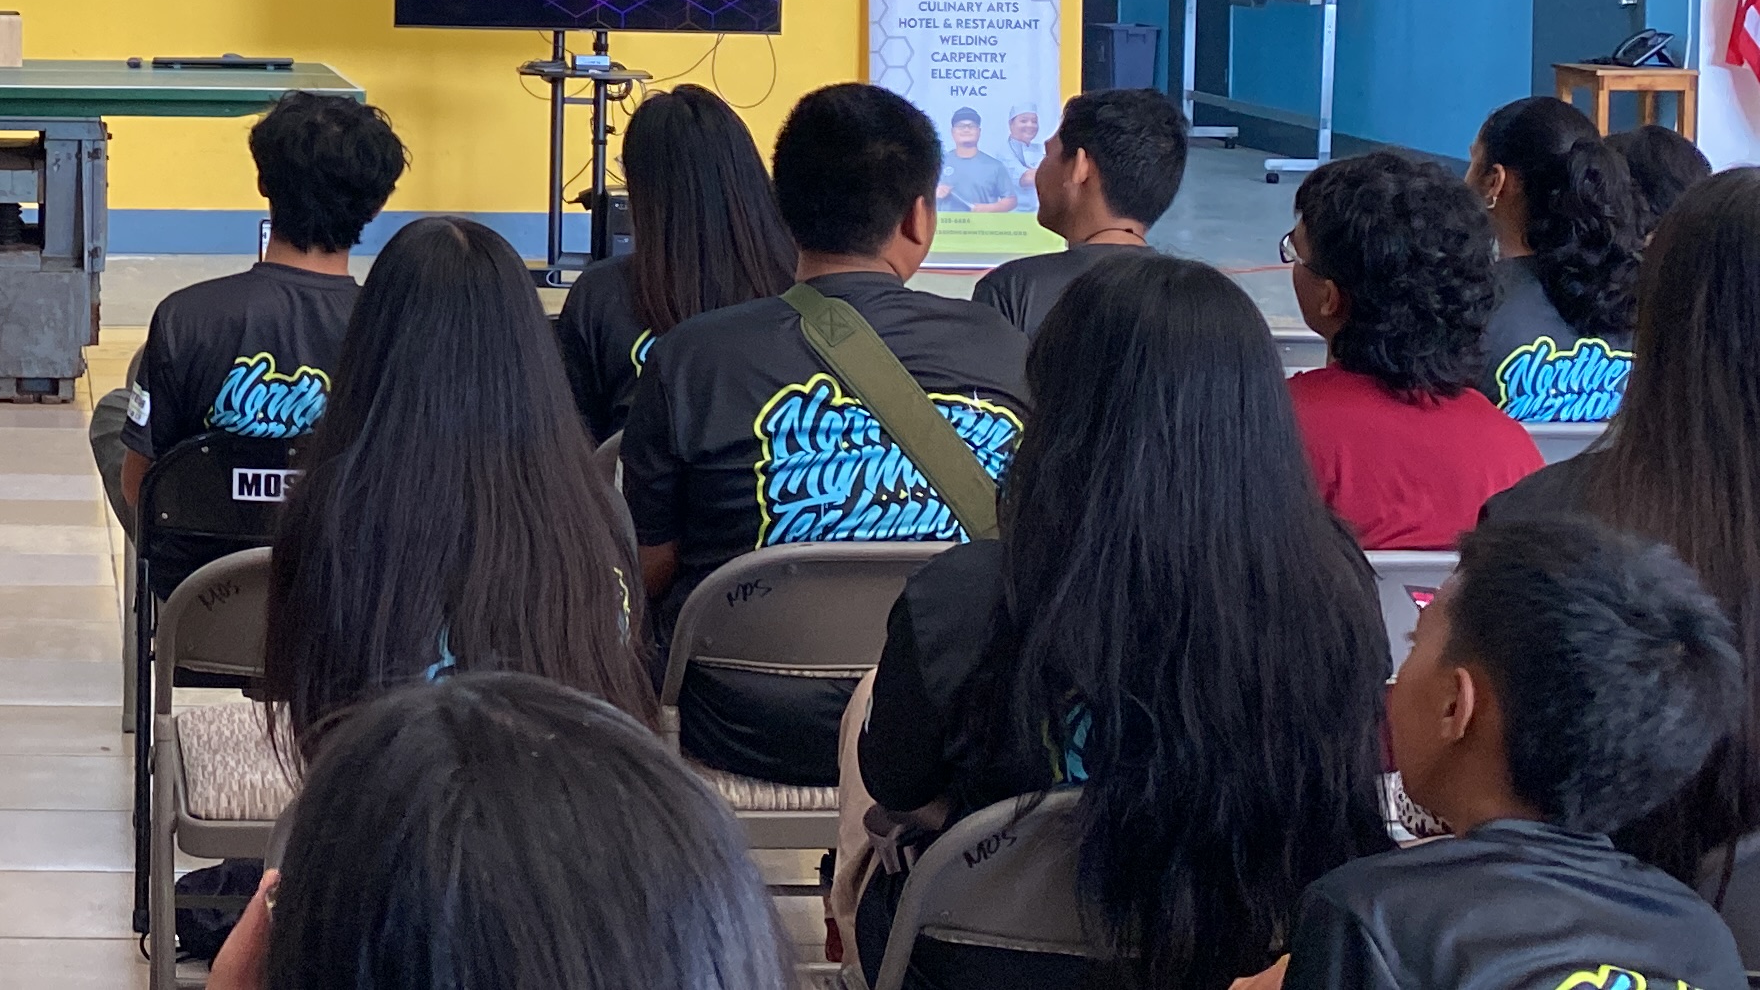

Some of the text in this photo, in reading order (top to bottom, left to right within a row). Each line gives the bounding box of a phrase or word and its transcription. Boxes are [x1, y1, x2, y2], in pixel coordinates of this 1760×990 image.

[918, 1, 1020, 13] CULINARY ARTS
[898, 18, 1040, 30] HOTEL & RESTAURANT
[939, 35, 998, 46] WELDING
[930, 52, 1007, 63] CARPENTRY
[930, 68, 1007, 80] ELECTRICAL
[950, 85, 988, 97] HVAC
